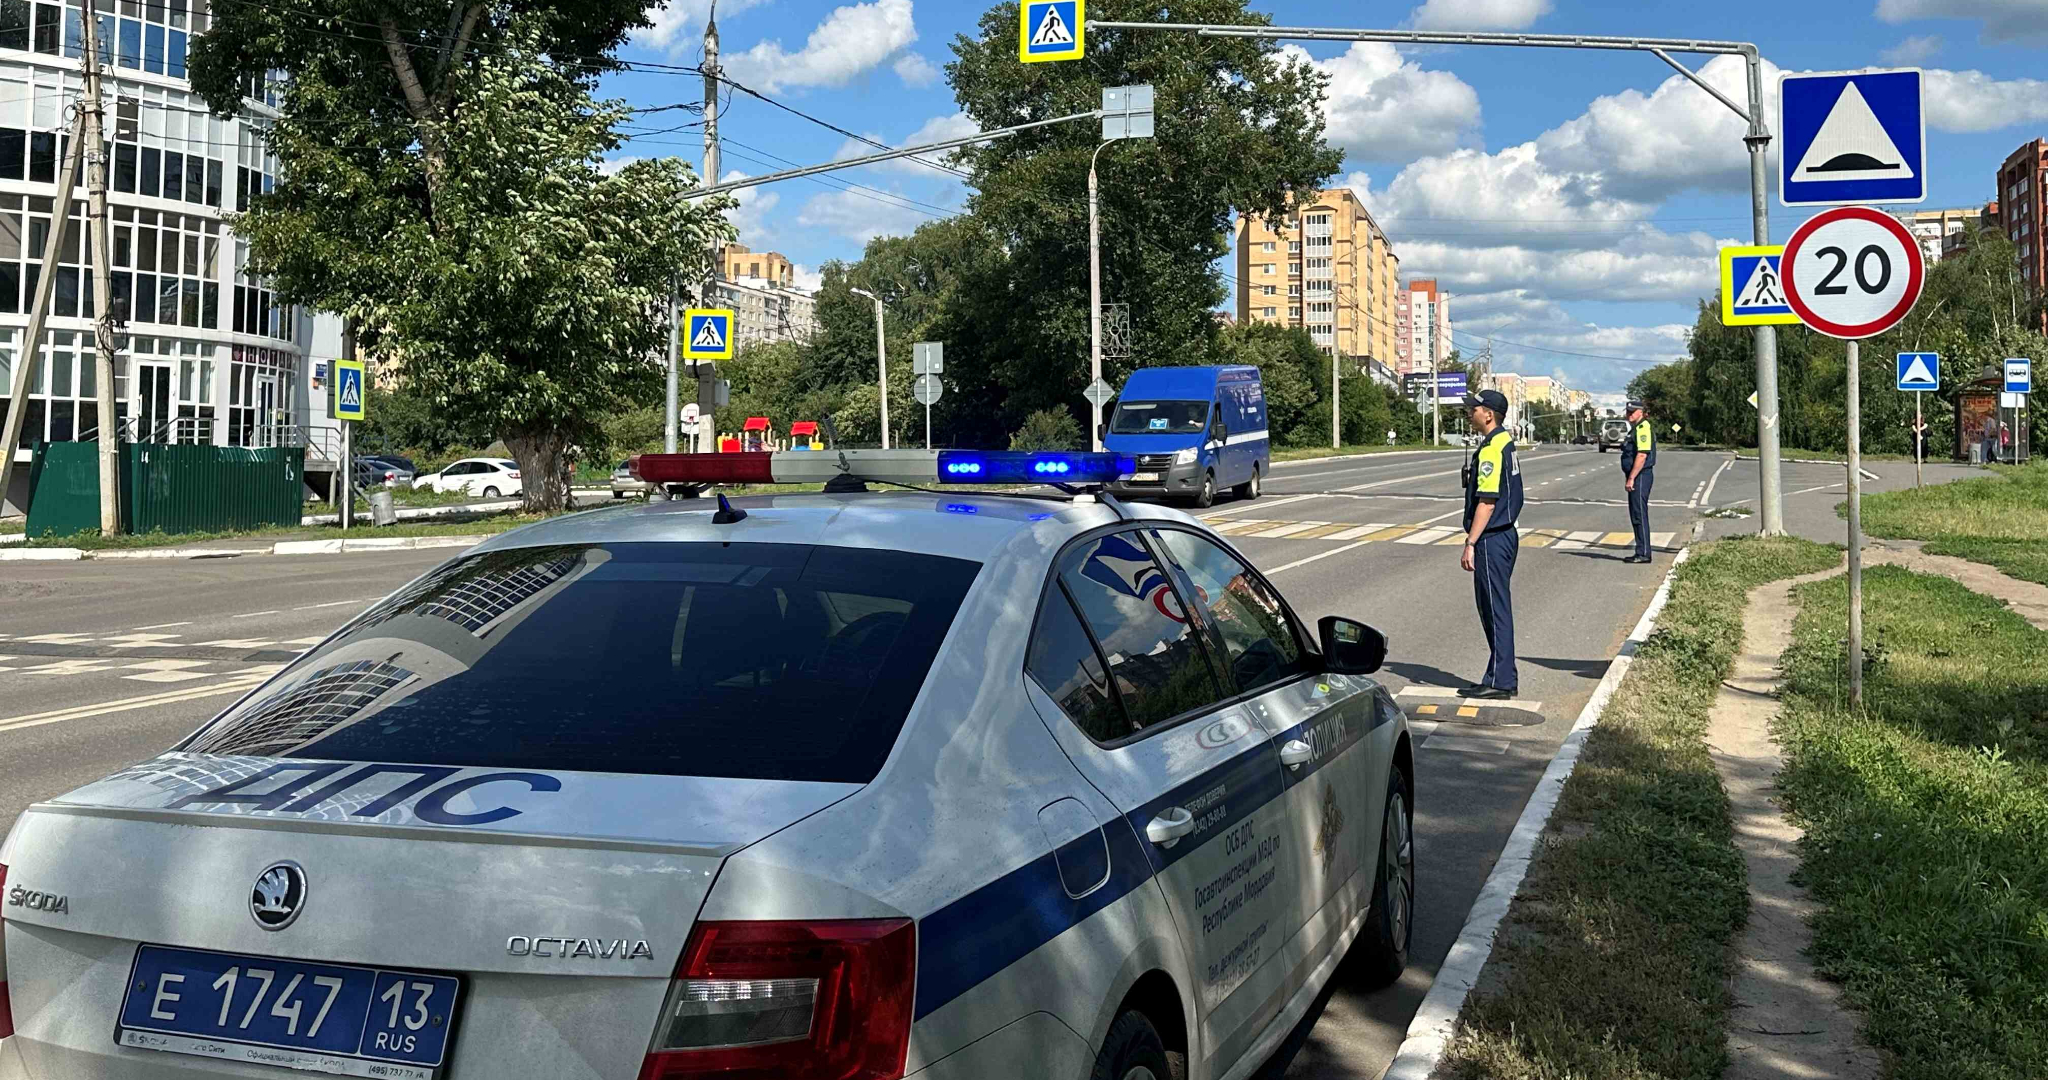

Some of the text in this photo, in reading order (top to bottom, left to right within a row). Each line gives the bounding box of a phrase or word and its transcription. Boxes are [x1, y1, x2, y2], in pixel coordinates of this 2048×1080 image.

[1814, 244, 1892, 296] 20
[165, 763, 562, 825] ДПС
[1226, 820, 1254, 856] ОСБ ДПС
[1195, 835, 1280, 910] Госавтоинспекции МВД по
[8, 884, 69, 915] ŠKODA
[1203, 892, 1243, 938] Республике
[506, 936, 654, 960] OCTAVIA
[212, 966, 343, 1038] 1747
[380, 980, 434, 1031] 13
[375, 1032, 417, 1053] RUS
